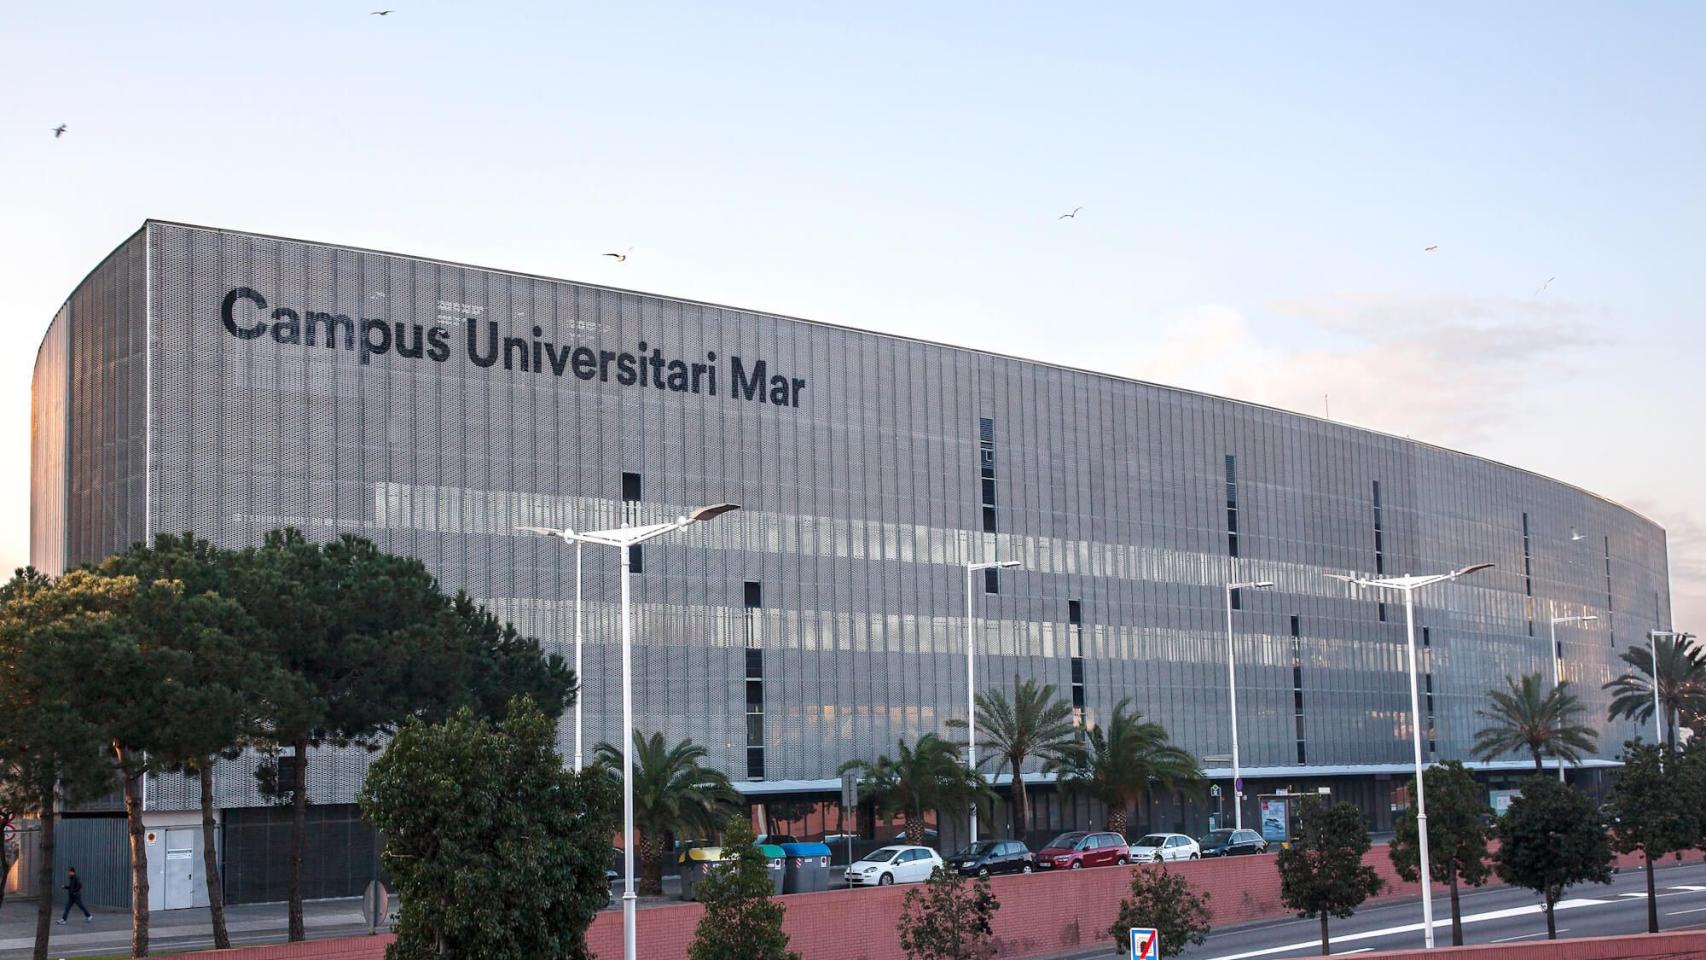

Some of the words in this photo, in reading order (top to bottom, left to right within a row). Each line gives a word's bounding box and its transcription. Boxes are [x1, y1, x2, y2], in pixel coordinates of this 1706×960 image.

[221, 286, 450, 365] Campus
[467, 318, 717, 396] Universitari
[731, 356, 806, 408] Mar
